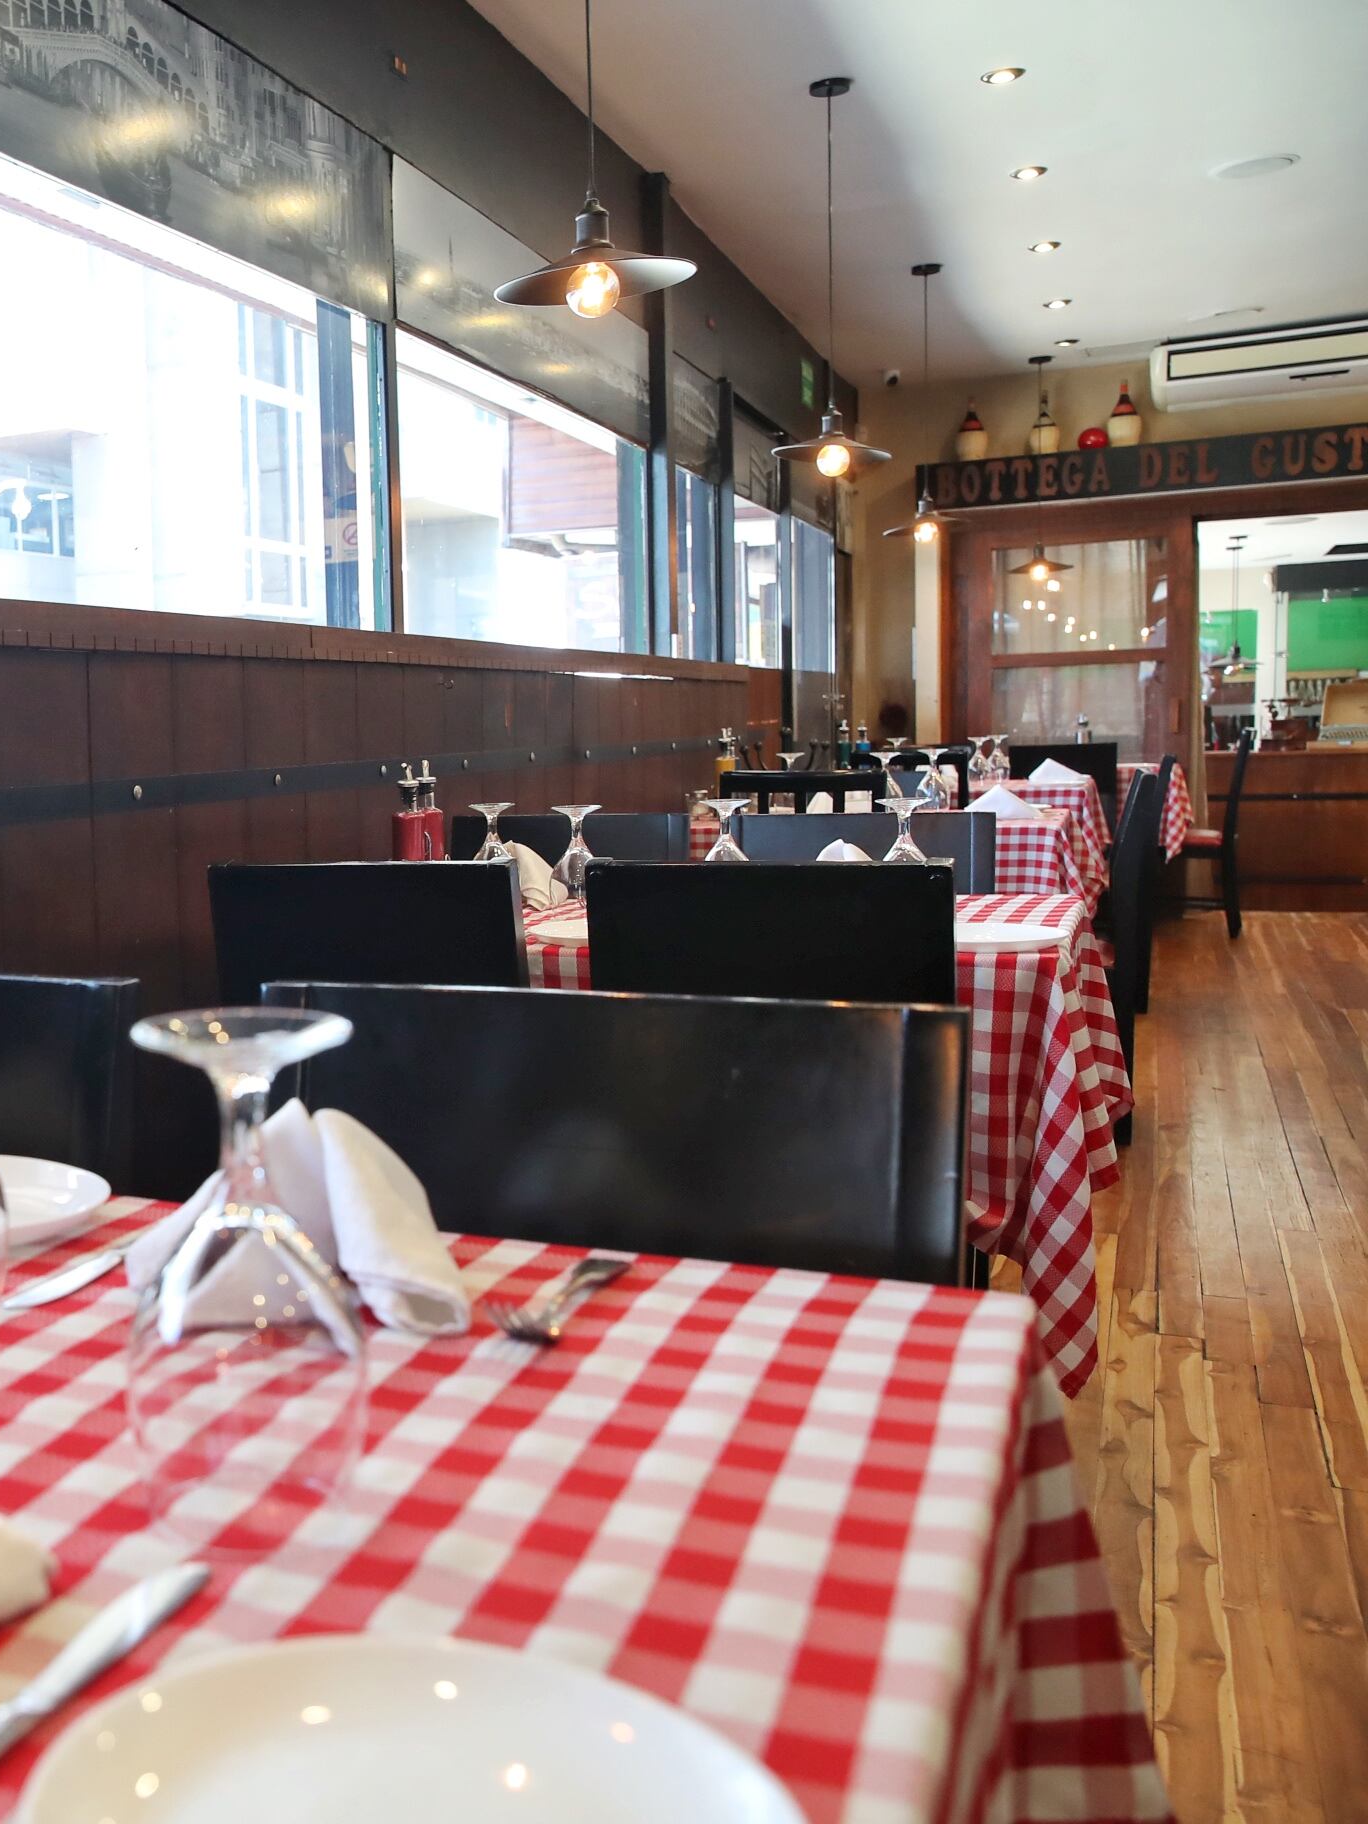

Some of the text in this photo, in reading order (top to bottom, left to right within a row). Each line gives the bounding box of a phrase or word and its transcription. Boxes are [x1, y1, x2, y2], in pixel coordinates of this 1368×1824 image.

[936, 427, 1368, 502] BOTTEGA DEL GUST
